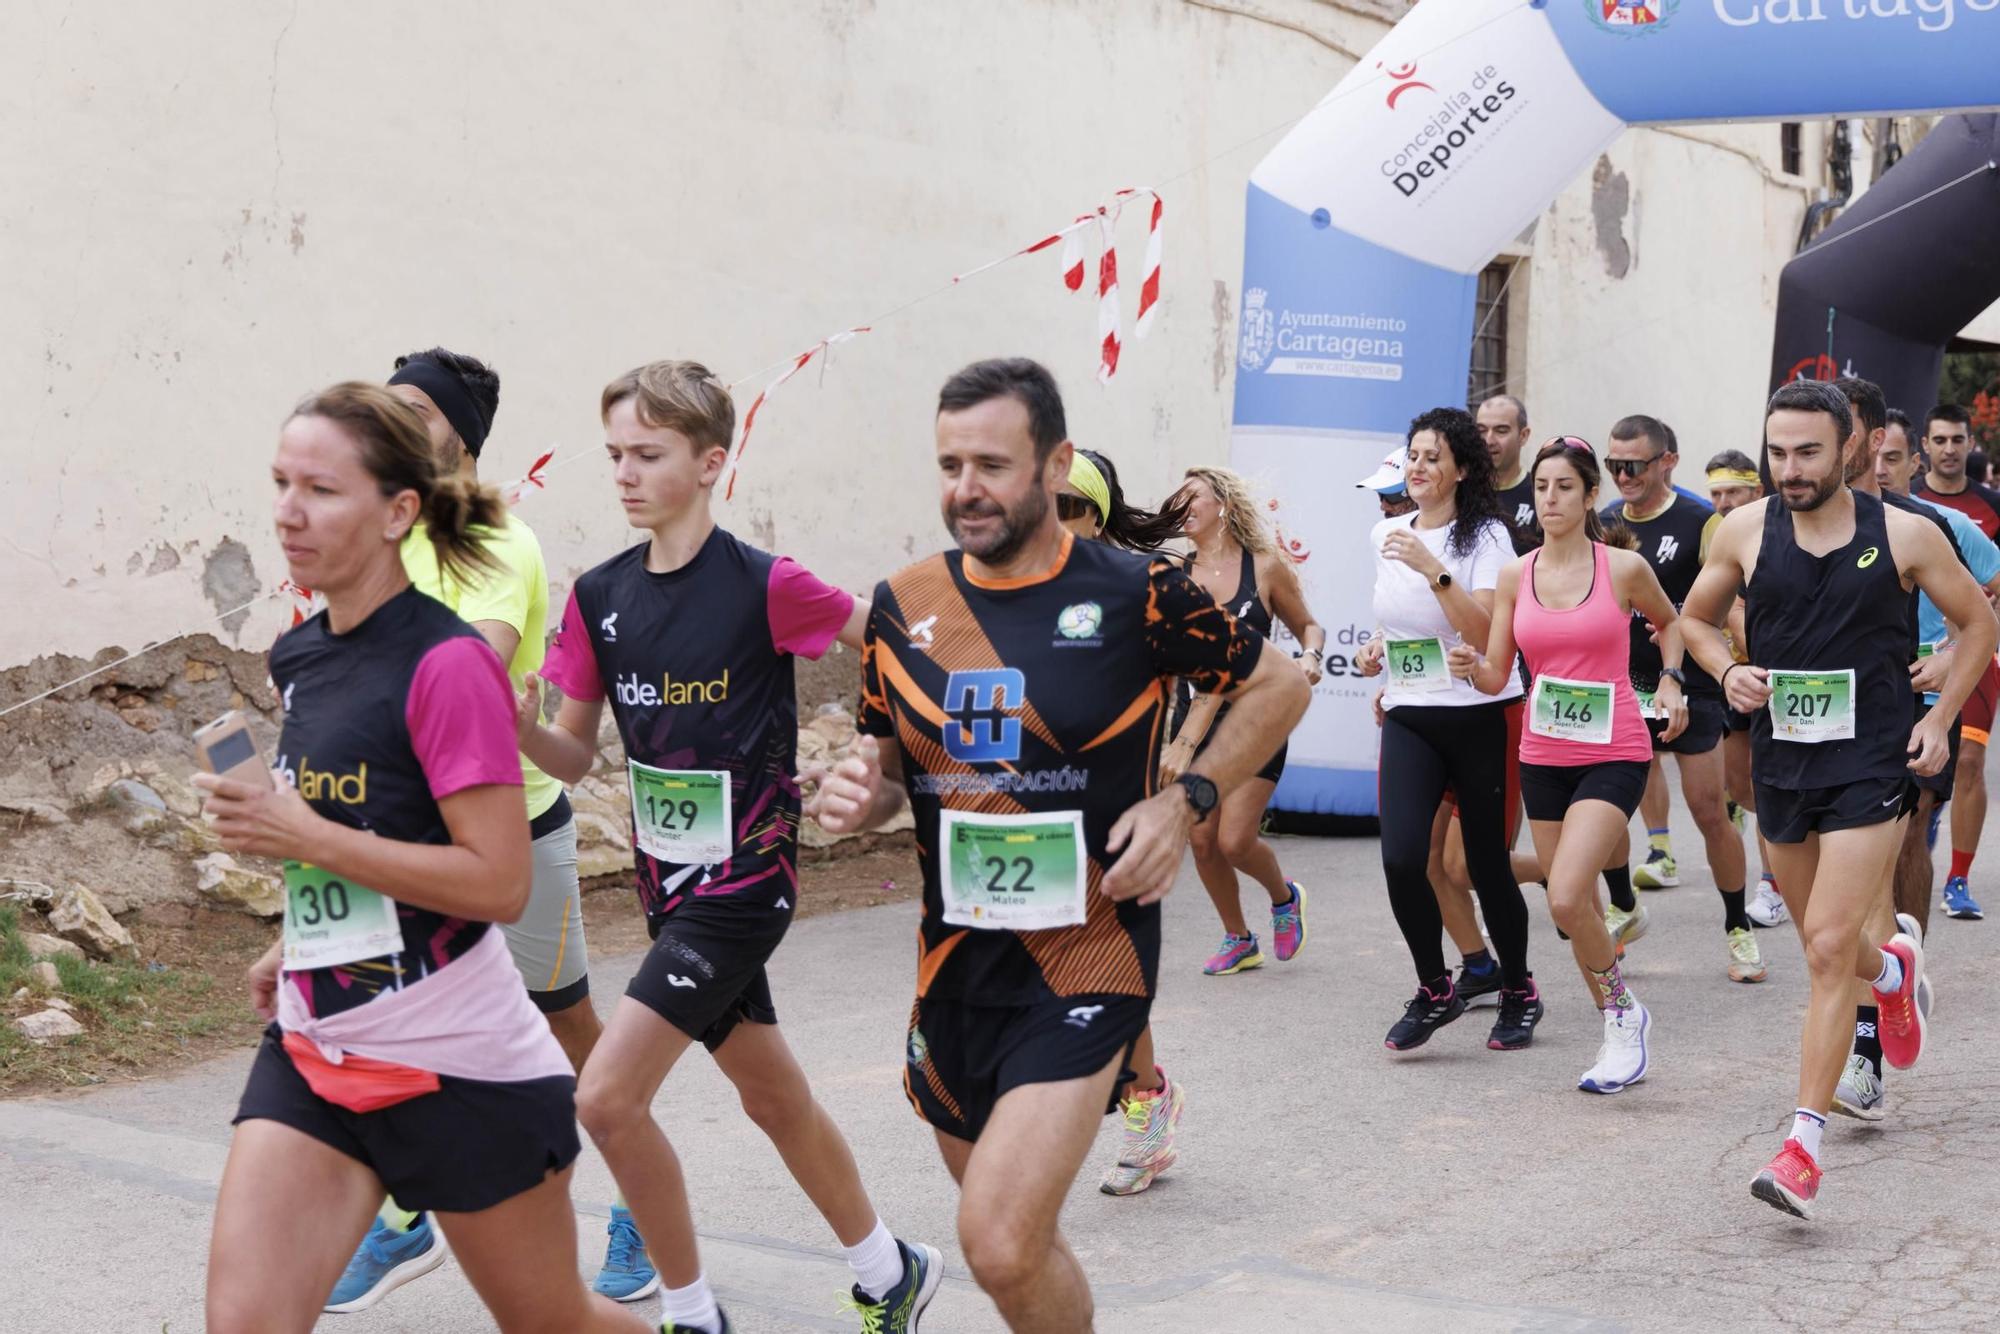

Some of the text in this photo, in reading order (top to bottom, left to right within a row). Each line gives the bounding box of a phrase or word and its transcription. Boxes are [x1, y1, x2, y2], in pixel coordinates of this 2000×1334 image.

[1380, 64, 1497, 177] Concejalía de
[1392, 81, 1515, 197] Deportes
[1280, 310, 1406, 332] Ayuntamiento
[1277, 329, 1403, 359] Cartagena
[1295, 361, 1399, 378] www.cartagena.es
[1338, 624, 1371, 645] de
[1402, 654, 1424, 673] 63
[1553, 700, 1592, 722] 146
[1787, 693, 1831, 717] 207
[646, 796, 698, 830] 129
[985, 856, 1035, 892] 22
[992, 895, 1026, 905] Mateo
